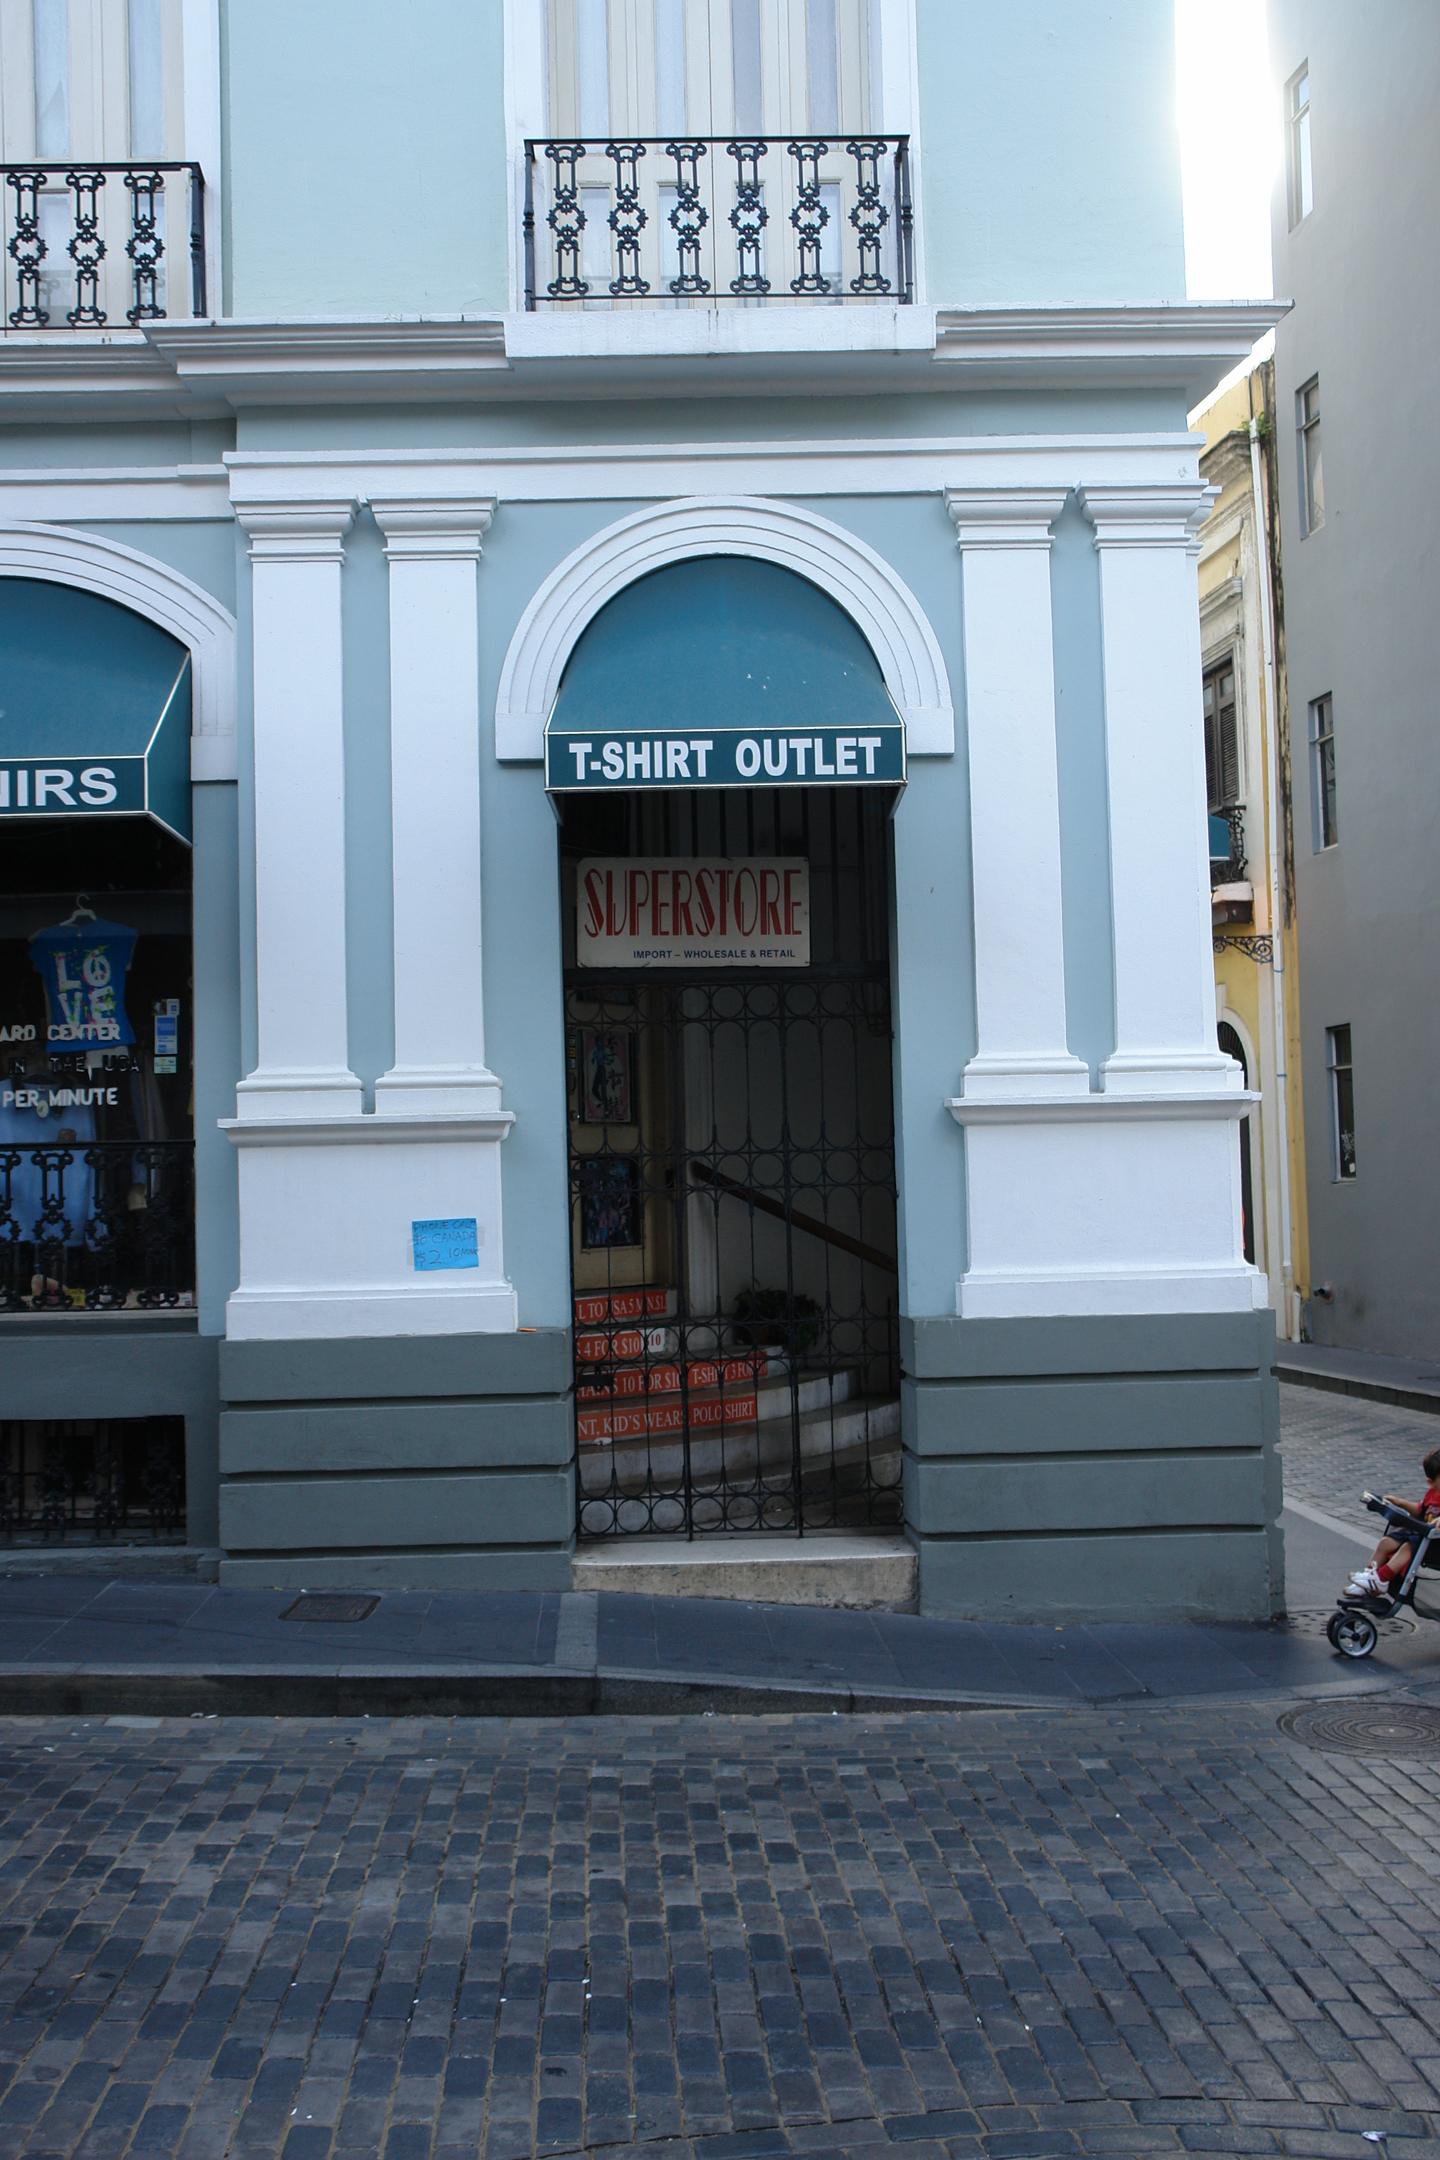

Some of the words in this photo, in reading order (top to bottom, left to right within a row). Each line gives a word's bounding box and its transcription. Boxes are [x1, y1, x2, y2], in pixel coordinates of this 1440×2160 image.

[568, 740, 714, 780] T-SHIRT
[735, 737, 882, 777] OUTLET
[0, 767, 117, 807] IRS
[583, 868, 803, 938] SUPERSTORE
[632, 949, 673, 960] IMPORT
[683, 949, 748, 960] WHOLESALE
[749, 949, 757, 960] &
[759, 949, 796, 960] RETAIL
[47, 1024, 121, 1041] CENTER
[50, 1057, 86, 1073] THE
[2, 1089, 39, 1108] PER
[49, 1087, 119, 1107] MINUTE
[588, 1302, 603, 1318] TO
[584, 1339, 591, 1356] 4
[594, 1337, 618, 1355] FOR
[623, 1375, 635, 1392] 10
[603, 1414, 639, 1433] KID'S
[693, 1404, 722, 1424] POLO
[725, 1400, 754, 1419] SHIRT
